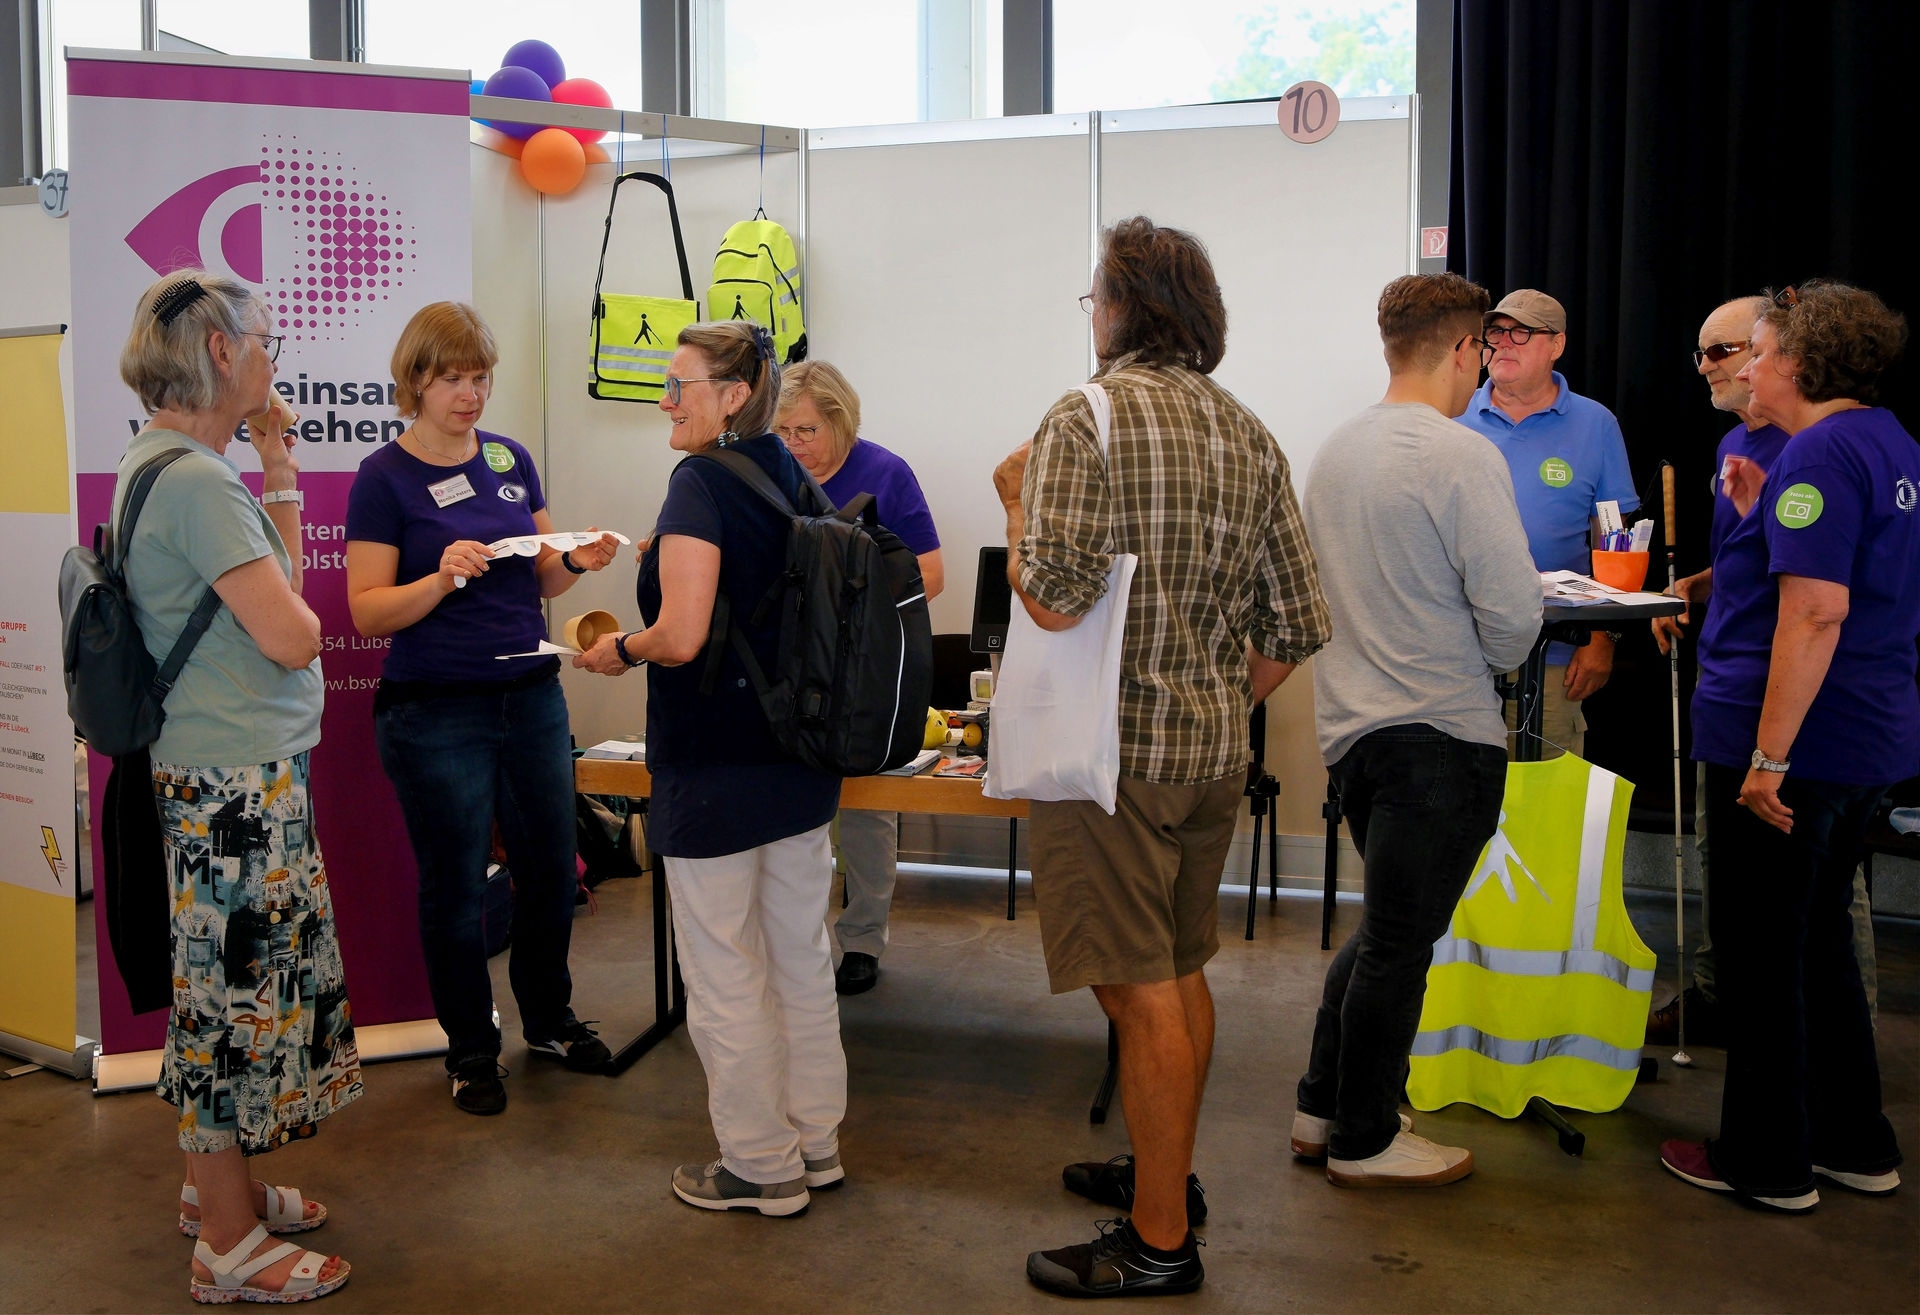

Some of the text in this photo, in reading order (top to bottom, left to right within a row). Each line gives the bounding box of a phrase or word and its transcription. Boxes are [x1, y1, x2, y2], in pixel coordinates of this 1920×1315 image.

[1286, 87, 1328, 134] 10
[43, 172, 69, 211] 37
[273, 373, 396, 405] einsa
[301, 522, 346, 540] ten
[302, 549, 347, 570] olst
[0, 621, 27, 632] GRUPPE
[352, 634, 393, 650] Lübe
